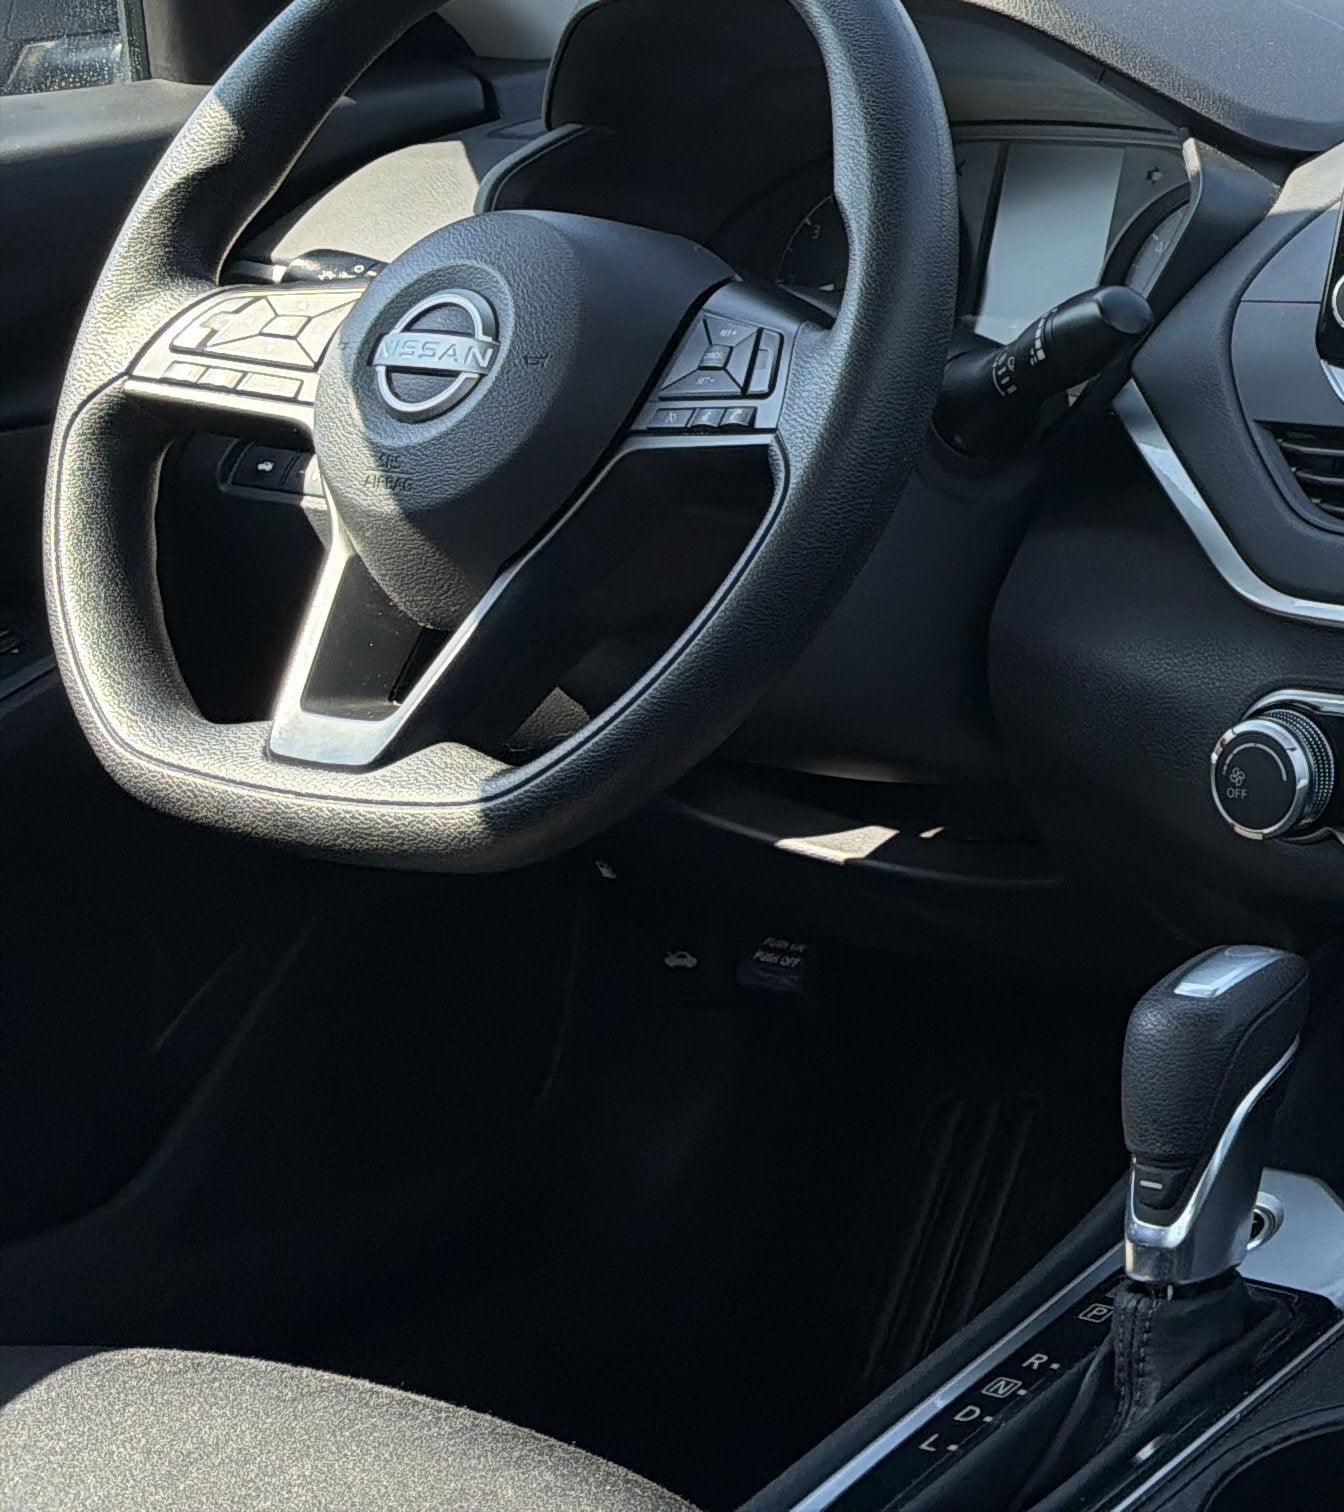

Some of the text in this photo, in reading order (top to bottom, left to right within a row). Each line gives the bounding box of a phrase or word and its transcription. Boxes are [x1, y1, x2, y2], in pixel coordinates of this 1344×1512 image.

[375, 338, 494, 368] NISSAN
[1226, 788, 1248, 800] OFF
[1021, 1353, 1049, 1370] R
[953, 1405, 981, 1422] D
[919, 1433, 940, 1452] L
